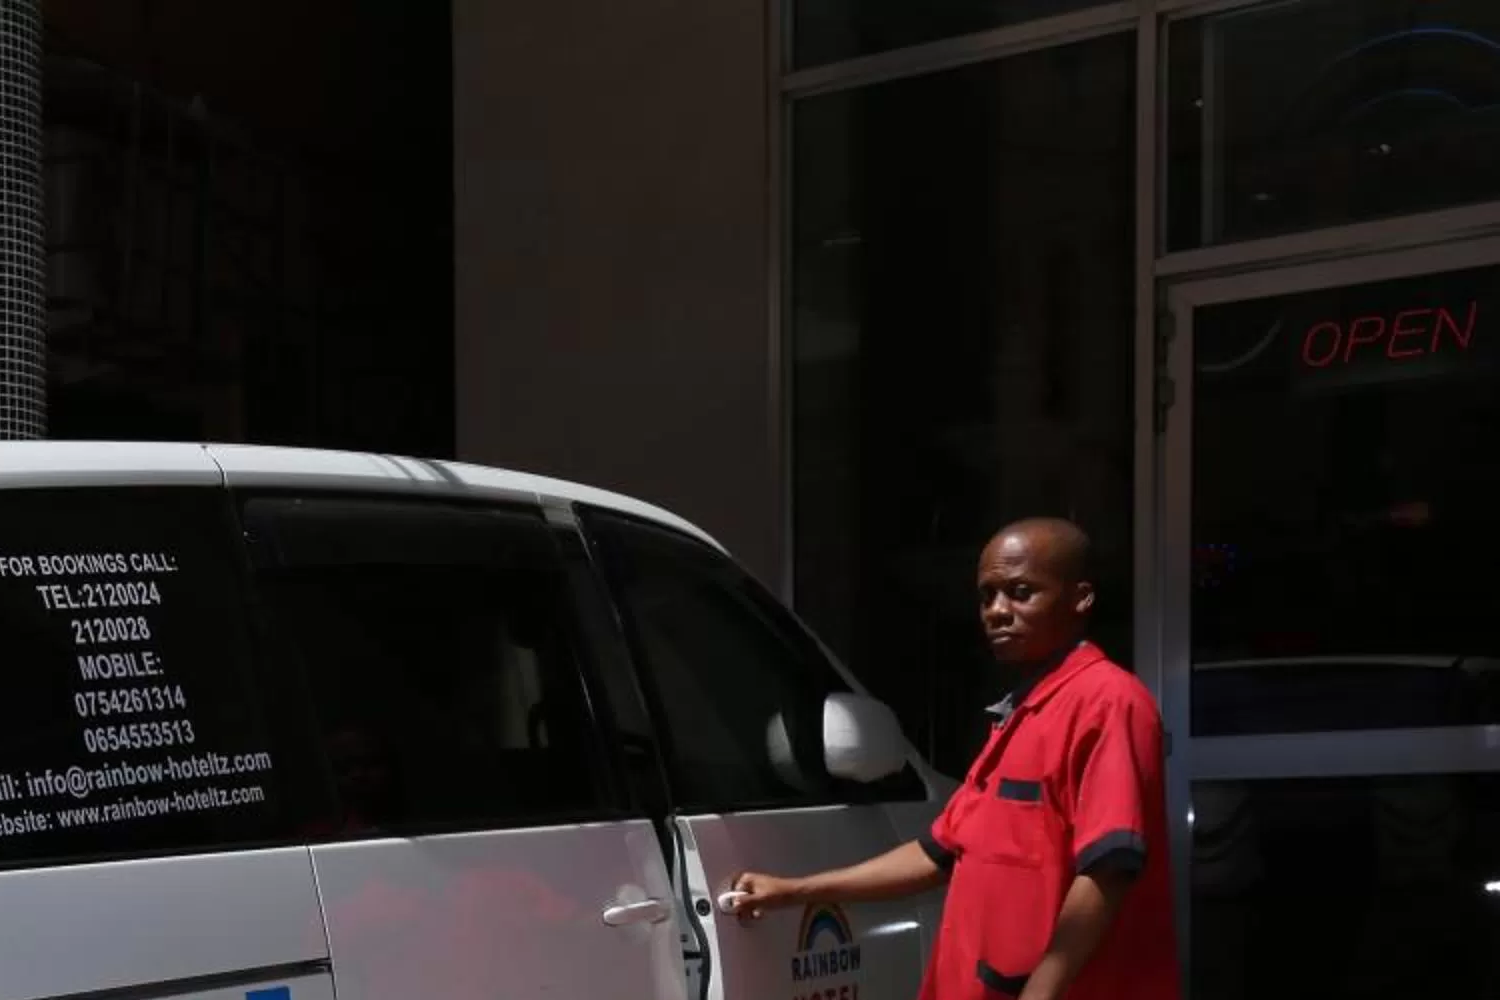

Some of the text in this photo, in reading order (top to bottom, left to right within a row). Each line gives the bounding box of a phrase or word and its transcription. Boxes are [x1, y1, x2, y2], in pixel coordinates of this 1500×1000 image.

[1301, 300, 1478, 368] OPEN
[38, 553, 128, 575] BOOKINGS
[130, 552, 179, 573] CALL:
[71, 616, 151, 645] 2120028
[78, 651, 164, 681] MOBILE:
[75, 685, 187, 717] 0754261314
[84, 719, 195, 753] 0654553513
[25, 751, 273, 799] info@rainbow-hoteltz.com
[56, 785, 265, 829] www.rainbow-hoteltz.com
[791, 946, 861, 982] RAINBOW
